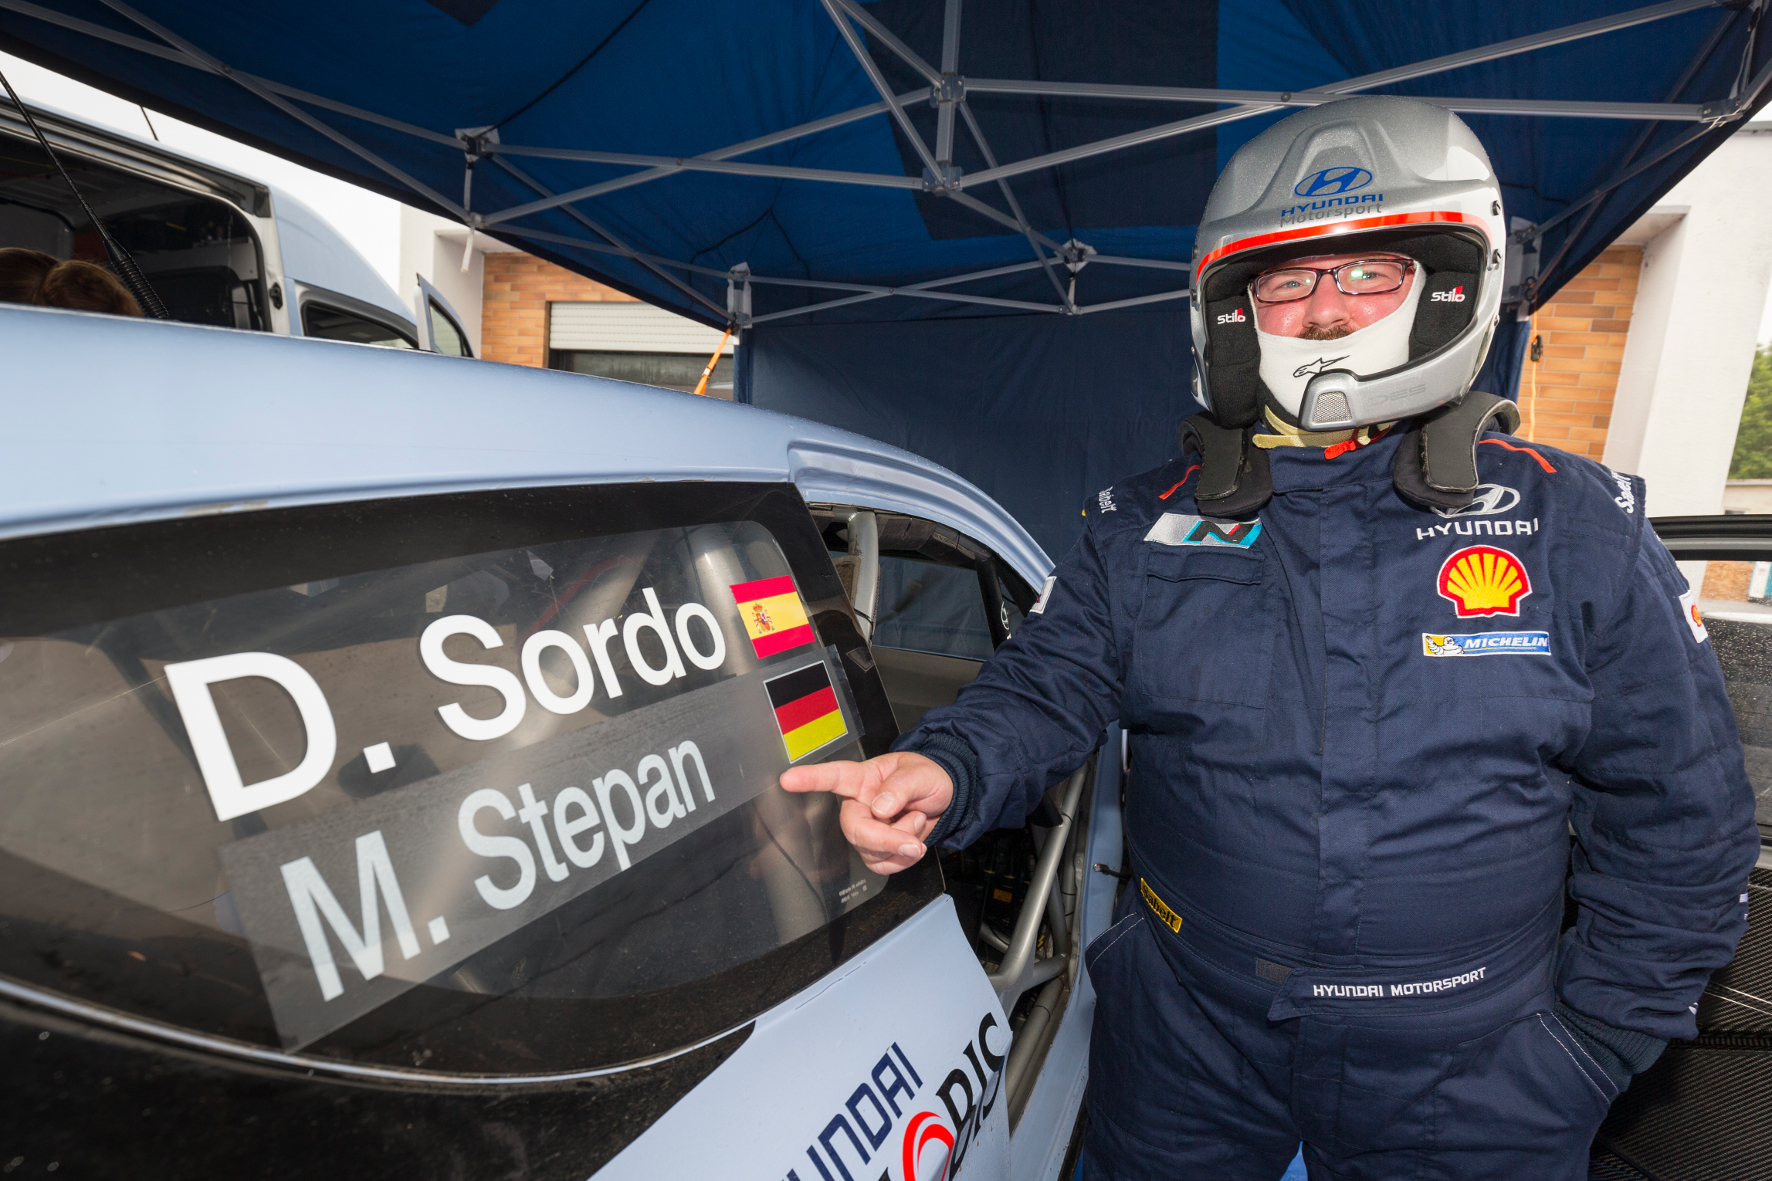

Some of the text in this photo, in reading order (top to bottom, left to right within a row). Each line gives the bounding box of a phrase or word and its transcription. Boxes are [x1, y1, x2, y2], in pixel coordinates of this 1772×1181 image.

[1280, 203, 1382, 227] Motorsport
[1281, 194, 1383, 217] HYUNDAI
[1430, 287, 1465, 302] stilo
[1217, 309, 1246, 325] stilo
[1416, 518, 1539, 540] HYUNDAI
[1464, 637, 1548, 649] MICHELIN
[164, 587, 726, 822] D. Sordo
[280, 740, 716, 1002] M. Stepan
[1313, 967, 1486, 997] HYUNDAI MOTORSPORT
